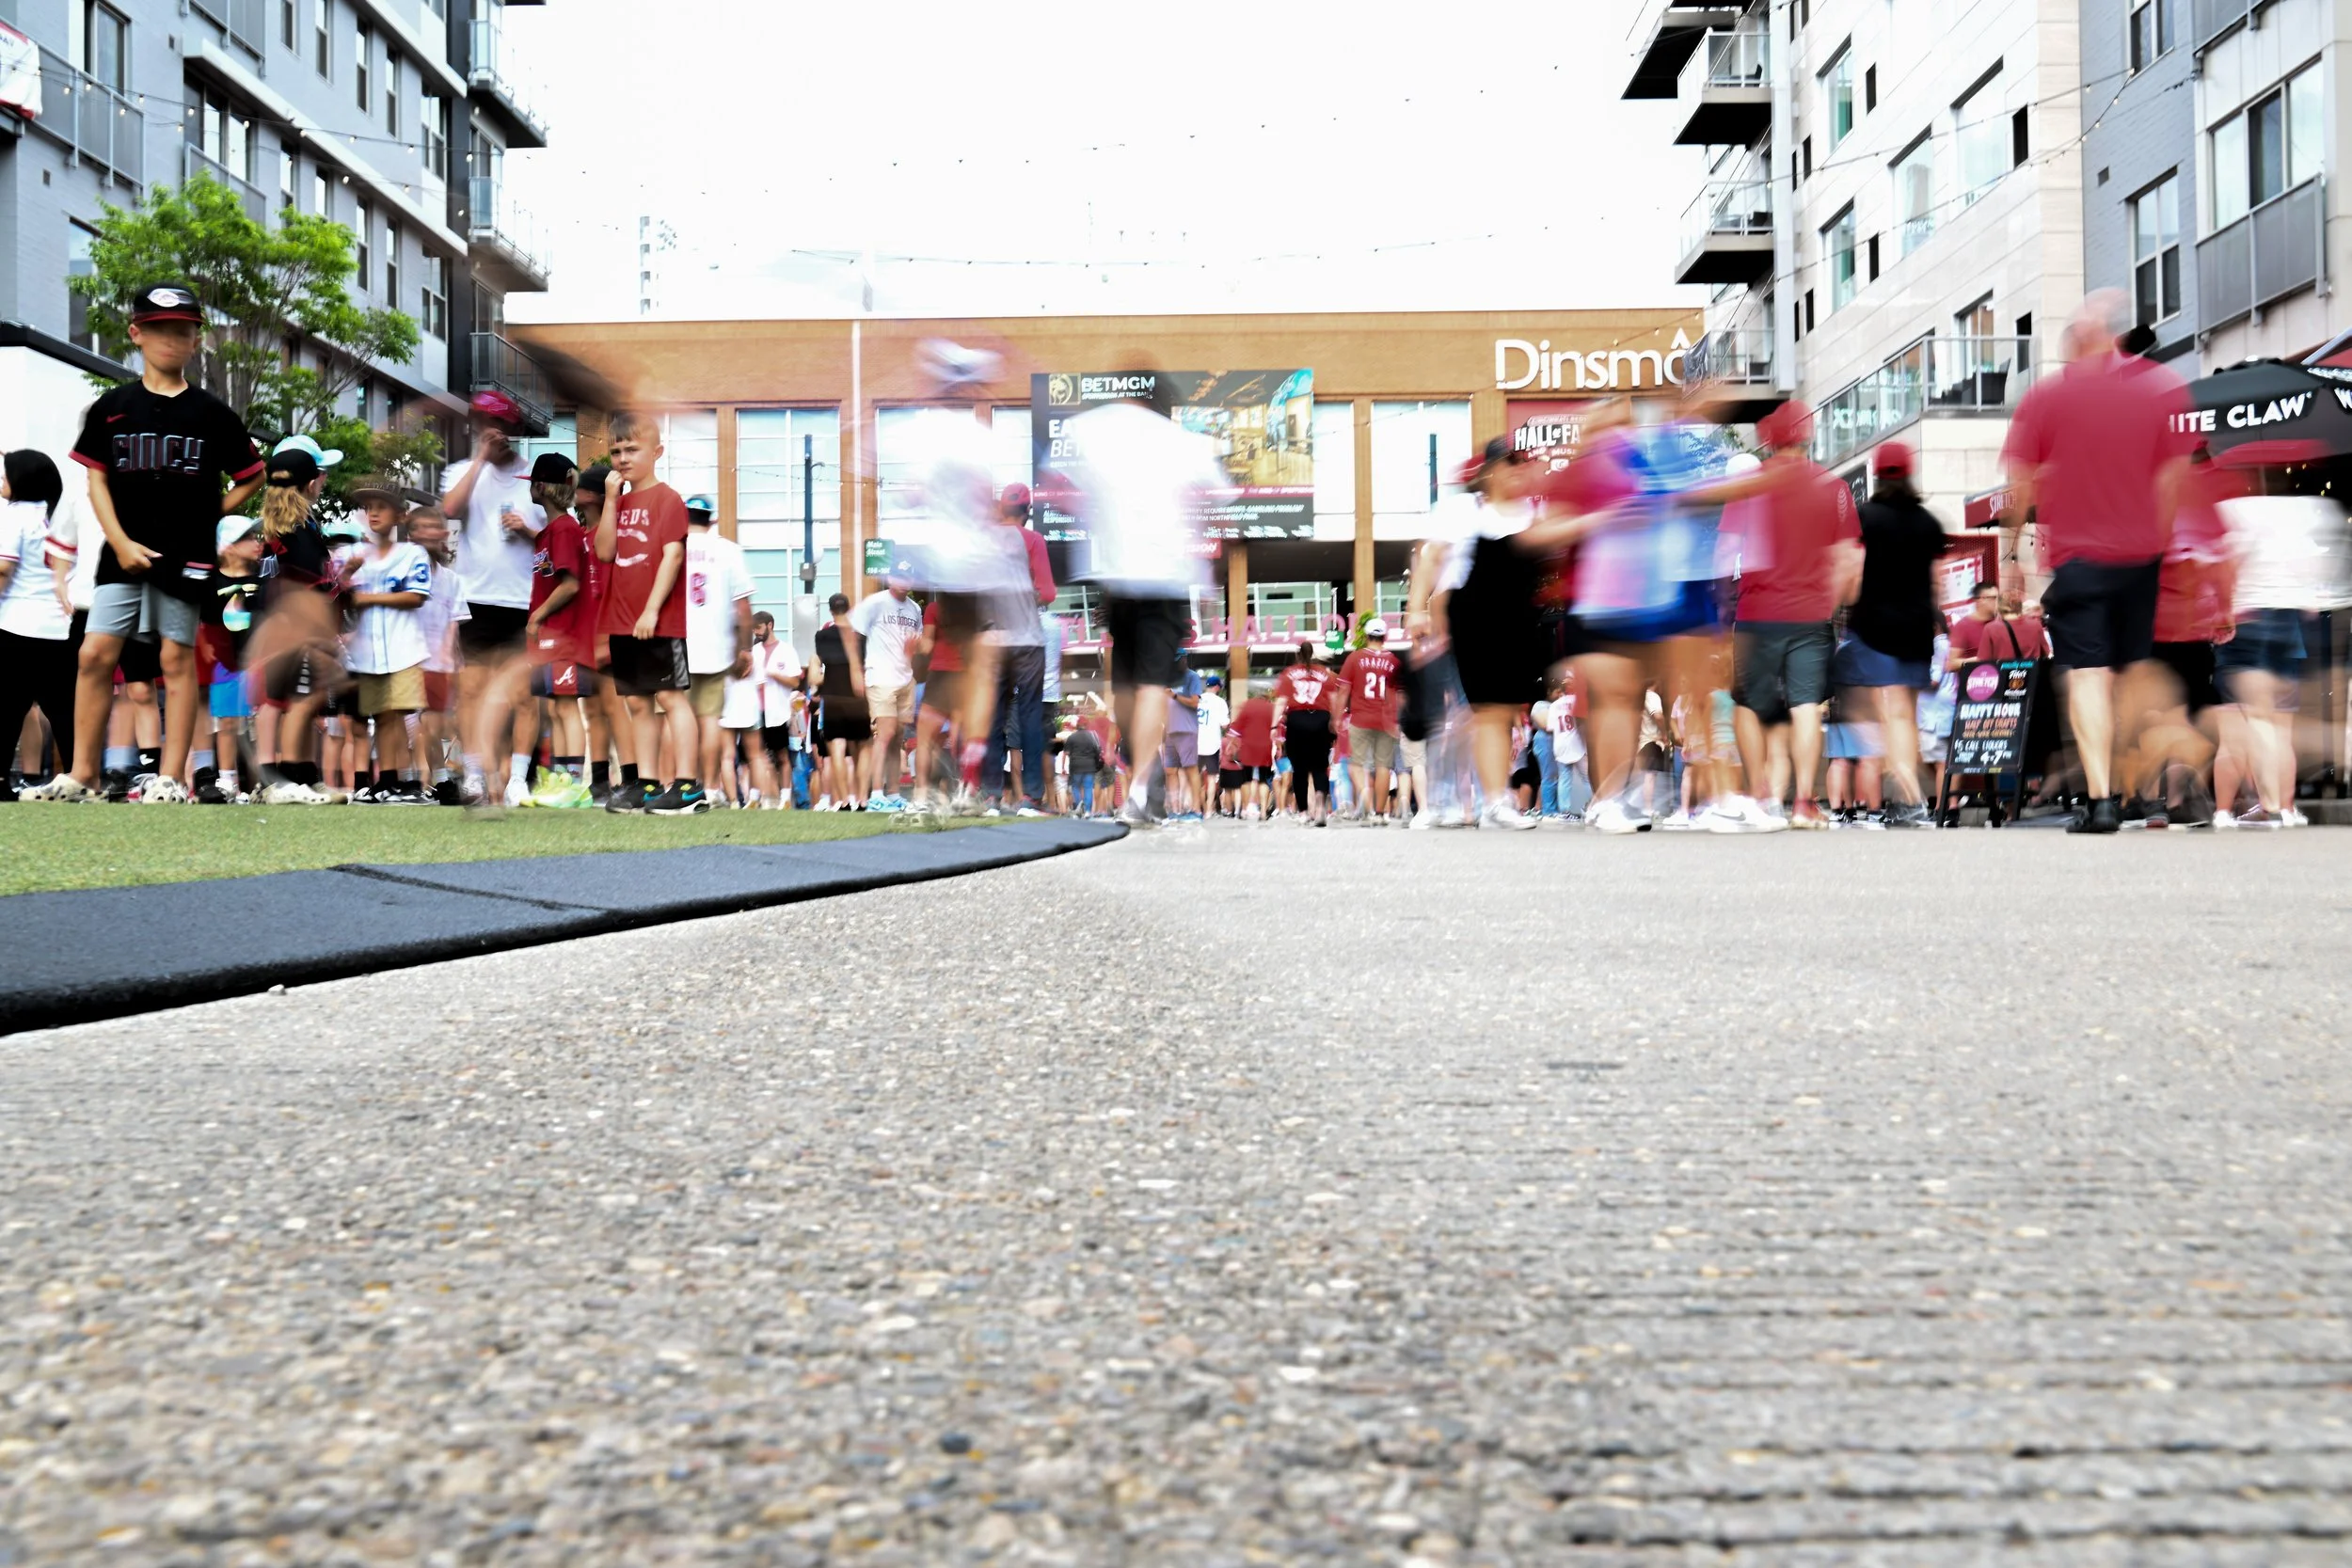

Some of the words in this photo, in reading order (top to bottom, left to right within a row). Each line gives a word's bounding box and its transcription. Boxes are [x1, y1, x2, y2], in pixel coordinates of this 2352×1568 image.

[1495, 326, 1691, 390] Dinsmô
[1081, 376, 1155, 392] BETMGM
[2169, 409, 2217, 433] ITE
[2226, 396, 2305, 429] CLAW
[1515, 424, 1557, 451] HALL
[1562, 424, 1581, 445] FA
[1550, 448, 1577, 456] MUSE
[616, 509, 651, 527] EDS
[1359, 657, 1395, 673] FRAZIER
[554, 664, 576, 686] A
[1364, 672, 1386, 700] 21
[1960, 703, 1994, 721] HAPPY
[1994, 703, 2021, 719] HOUR
[1558, 714, 1574, 733] 19
